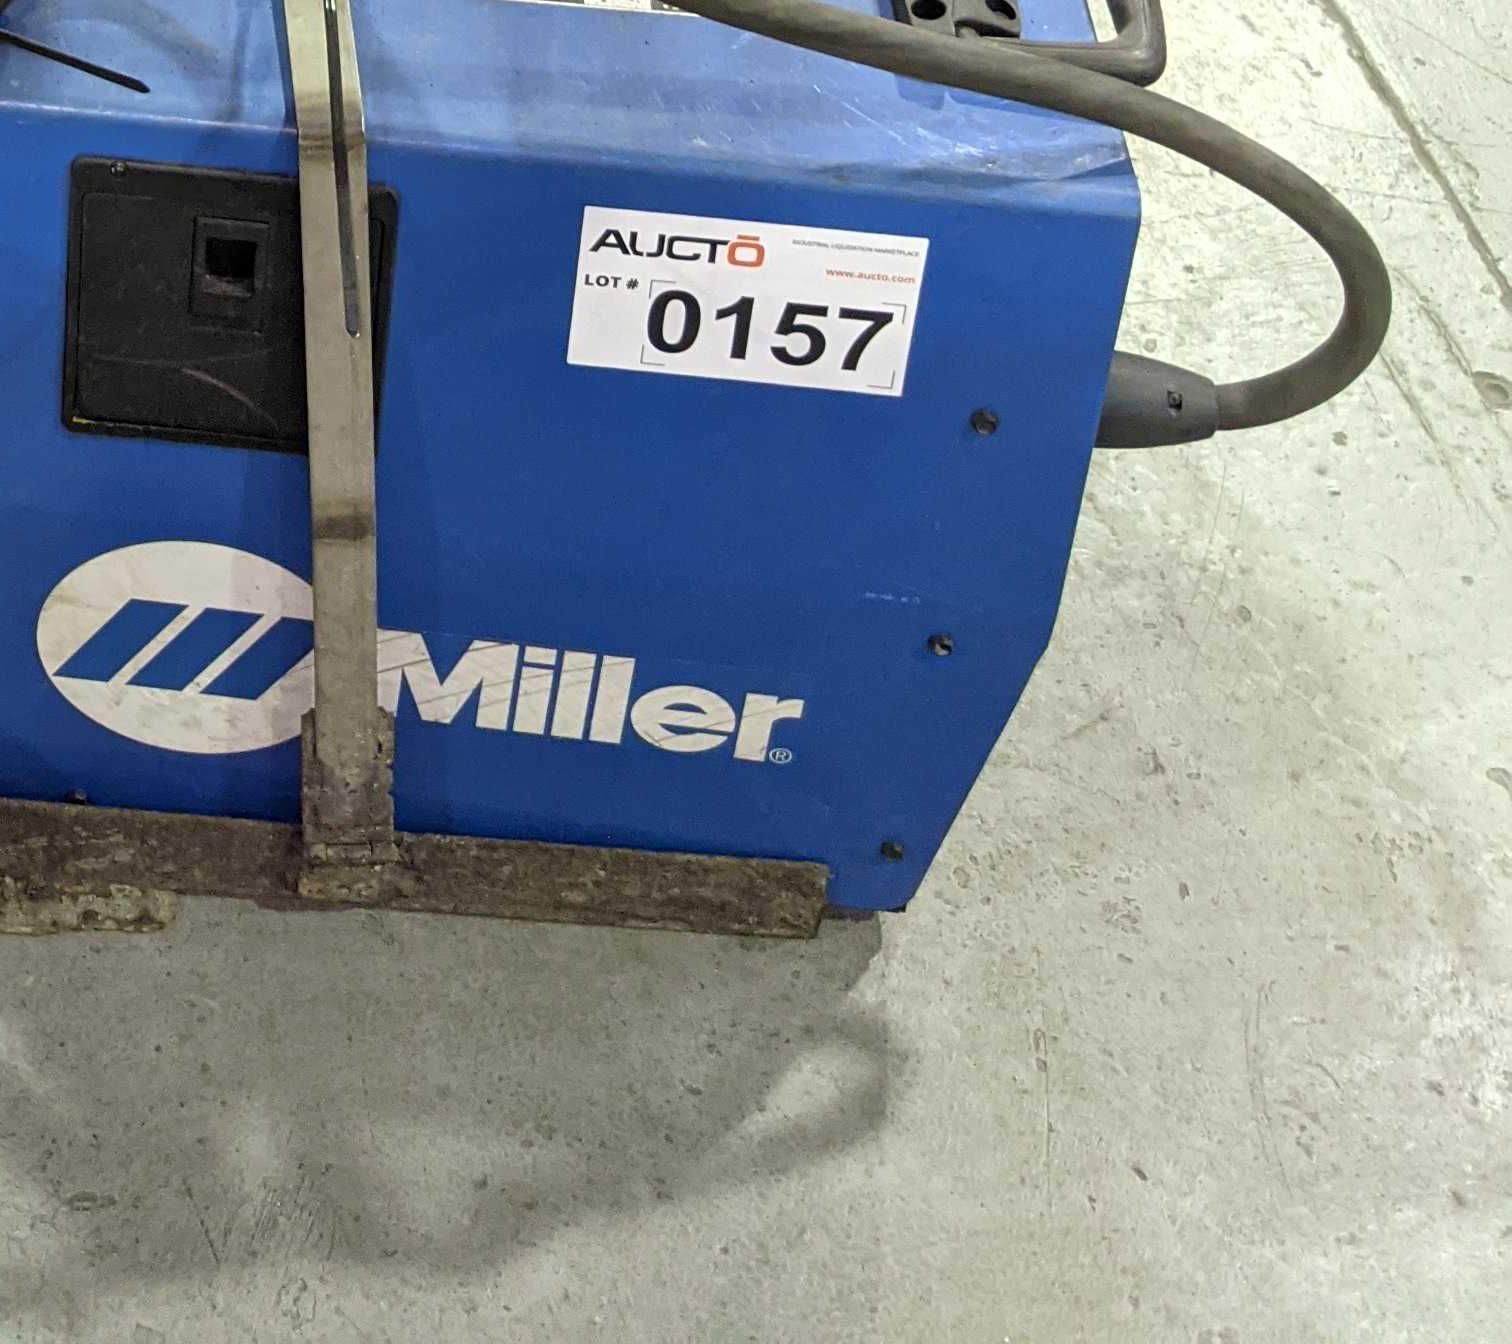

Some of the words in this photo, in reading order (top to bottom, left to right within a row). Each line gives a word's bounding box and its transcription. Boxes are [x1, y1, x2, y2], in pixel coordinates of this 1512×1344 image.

[584, 273, 622, 289] LOT
[626, 278, 639, 290] #
[825, 268, 916, 284] www.aucto.com
[646, 289, 895, 372] 0157
[376, 626, 805, 764] Miller
